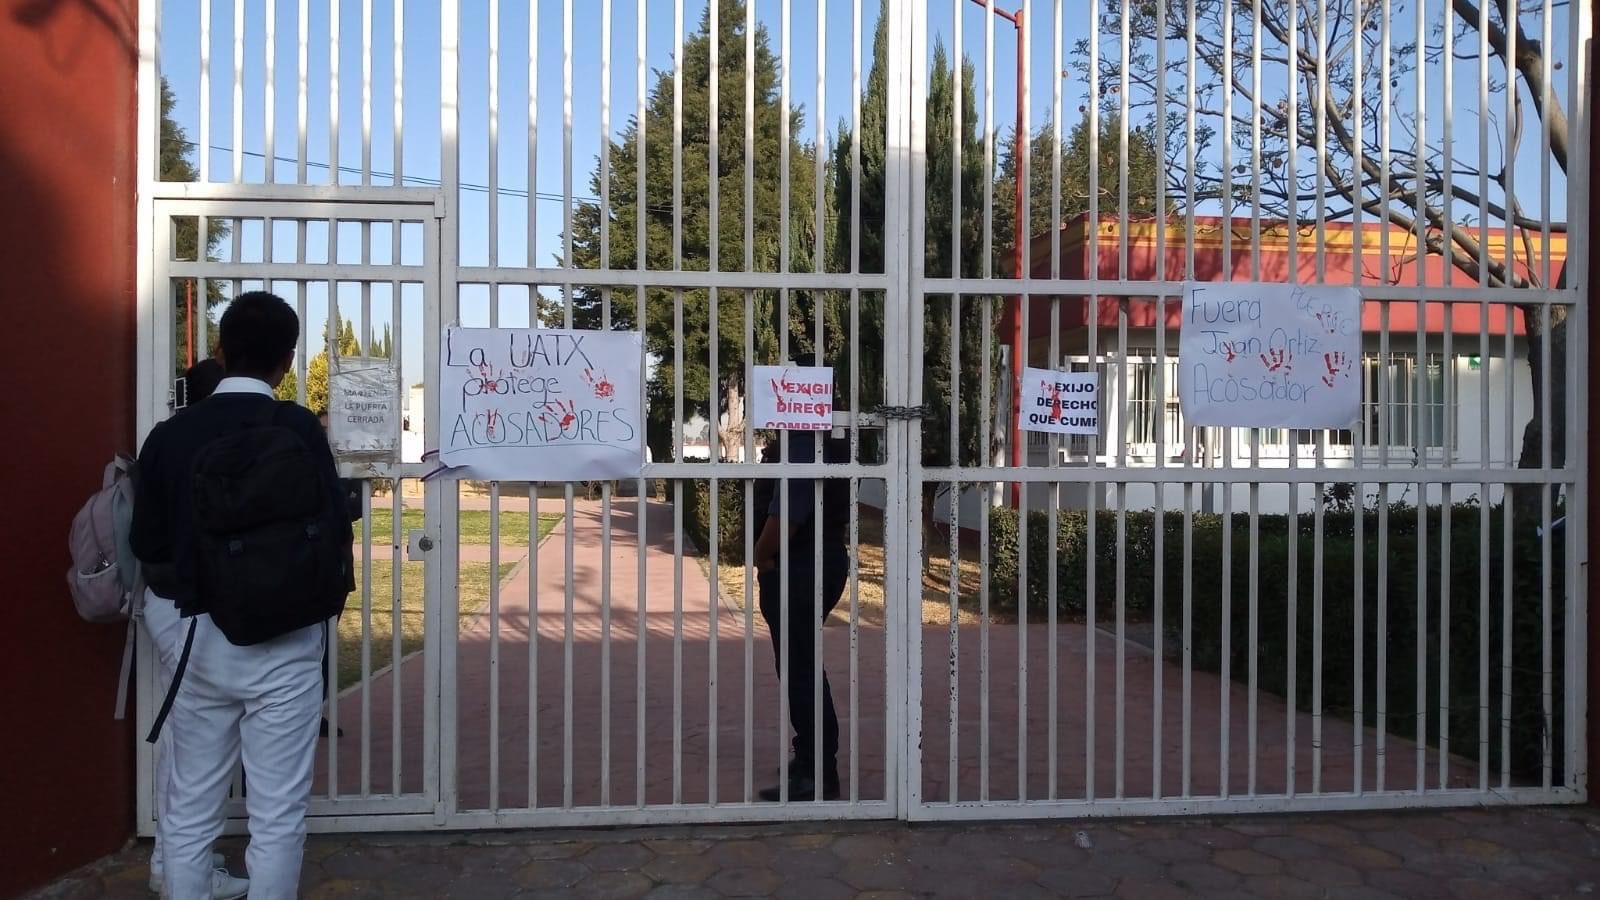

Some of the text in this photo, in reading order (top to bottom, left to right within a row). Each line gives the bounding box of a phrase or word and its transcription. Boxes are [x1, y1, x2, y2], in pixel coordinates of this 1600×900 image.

[1191, 287, 1262, 328] Fuera
[446, 329, 594, 370] La UATX
[1200, 327, 1321, 356] Juan Ortiz
[462, 371, 563, 413] protege
[1055, 382, 1095, 393] EXIJO
[1193, 362, 1315, 405] Acosador
[347, 415, 385, 424] CERRADA
[450, 408, 635, 447] ACOSADORES
[1029, 413, 1056, 425] QUE
